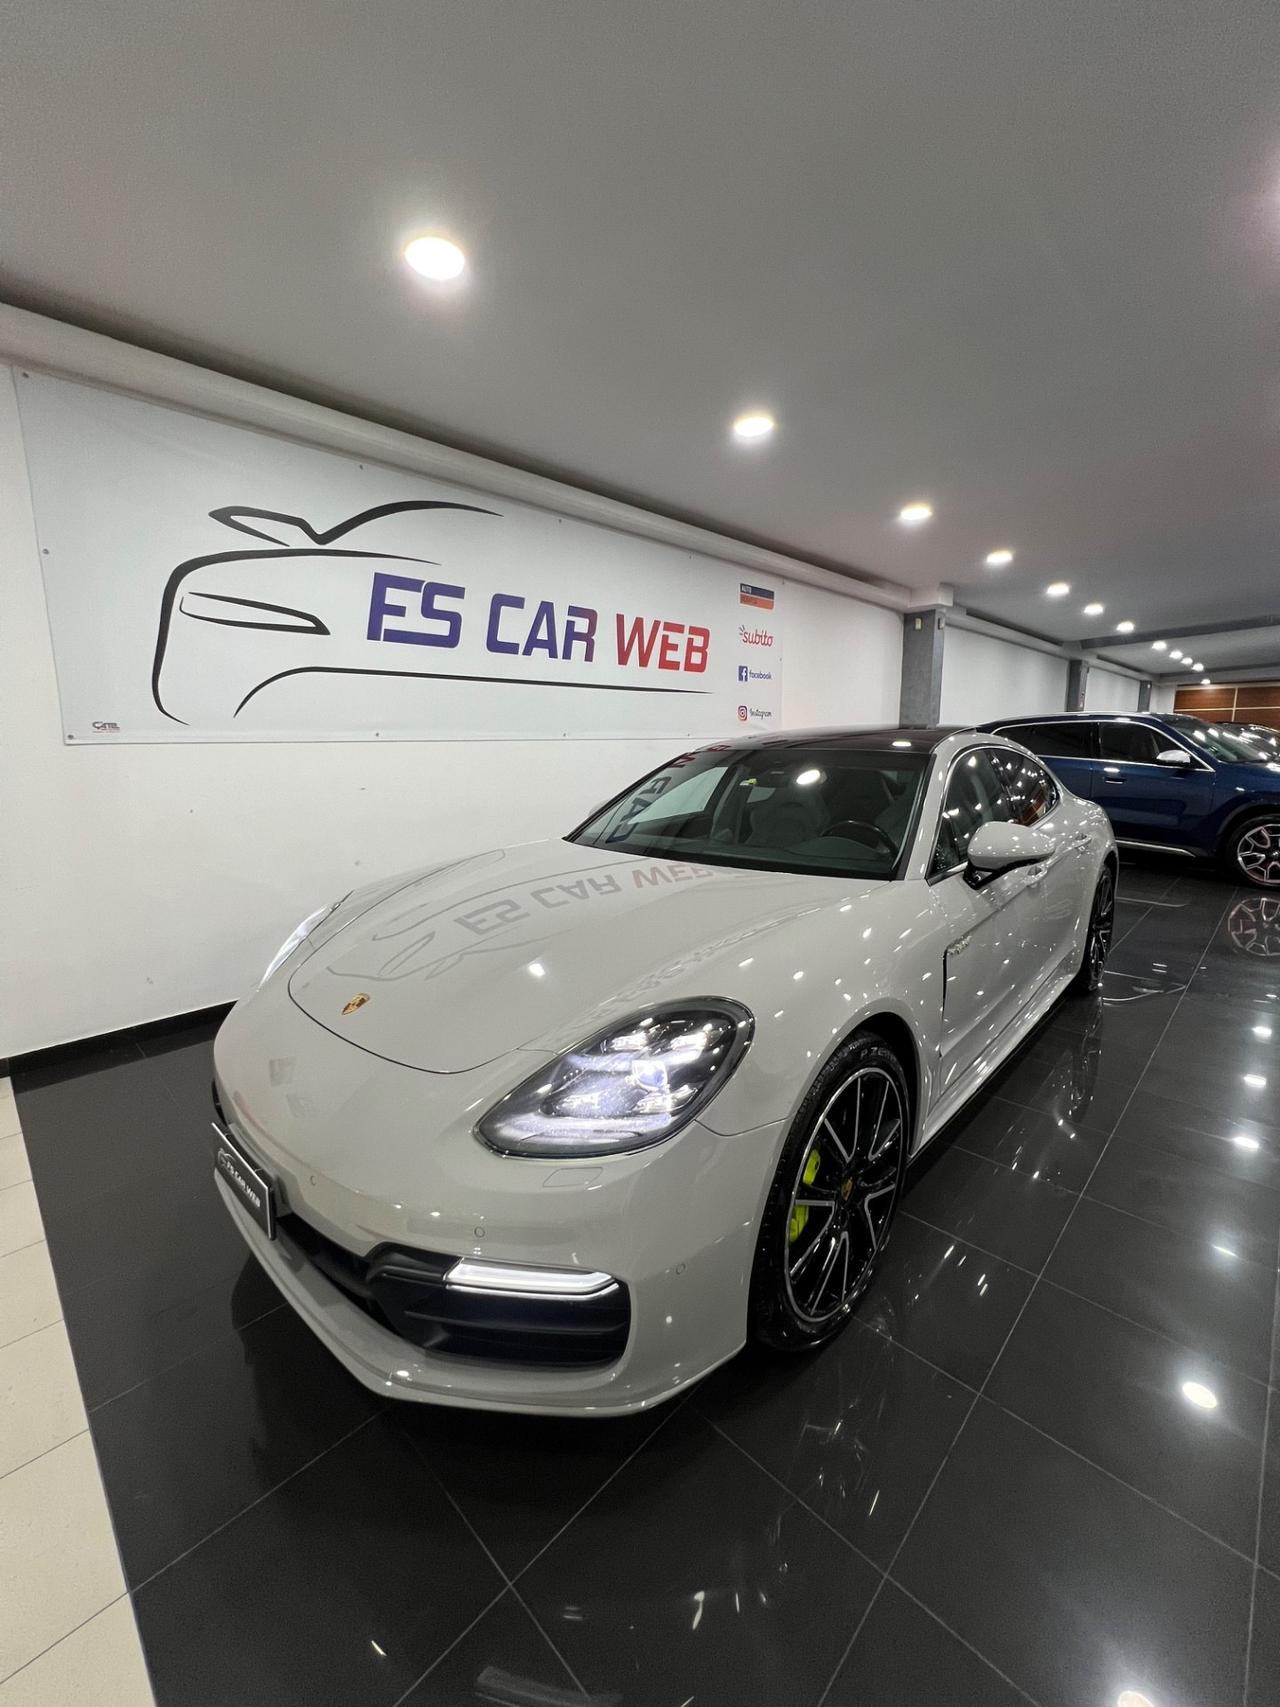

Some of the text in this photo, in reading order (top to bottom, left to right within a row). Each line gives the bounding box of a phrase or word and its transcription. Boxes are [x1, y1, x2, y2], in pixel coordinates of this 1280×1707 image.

[366, 571, 711, 673] ES CAR WEB
[743, 628, 774, 647] subito
[749, 669, 772, 680] facebook
